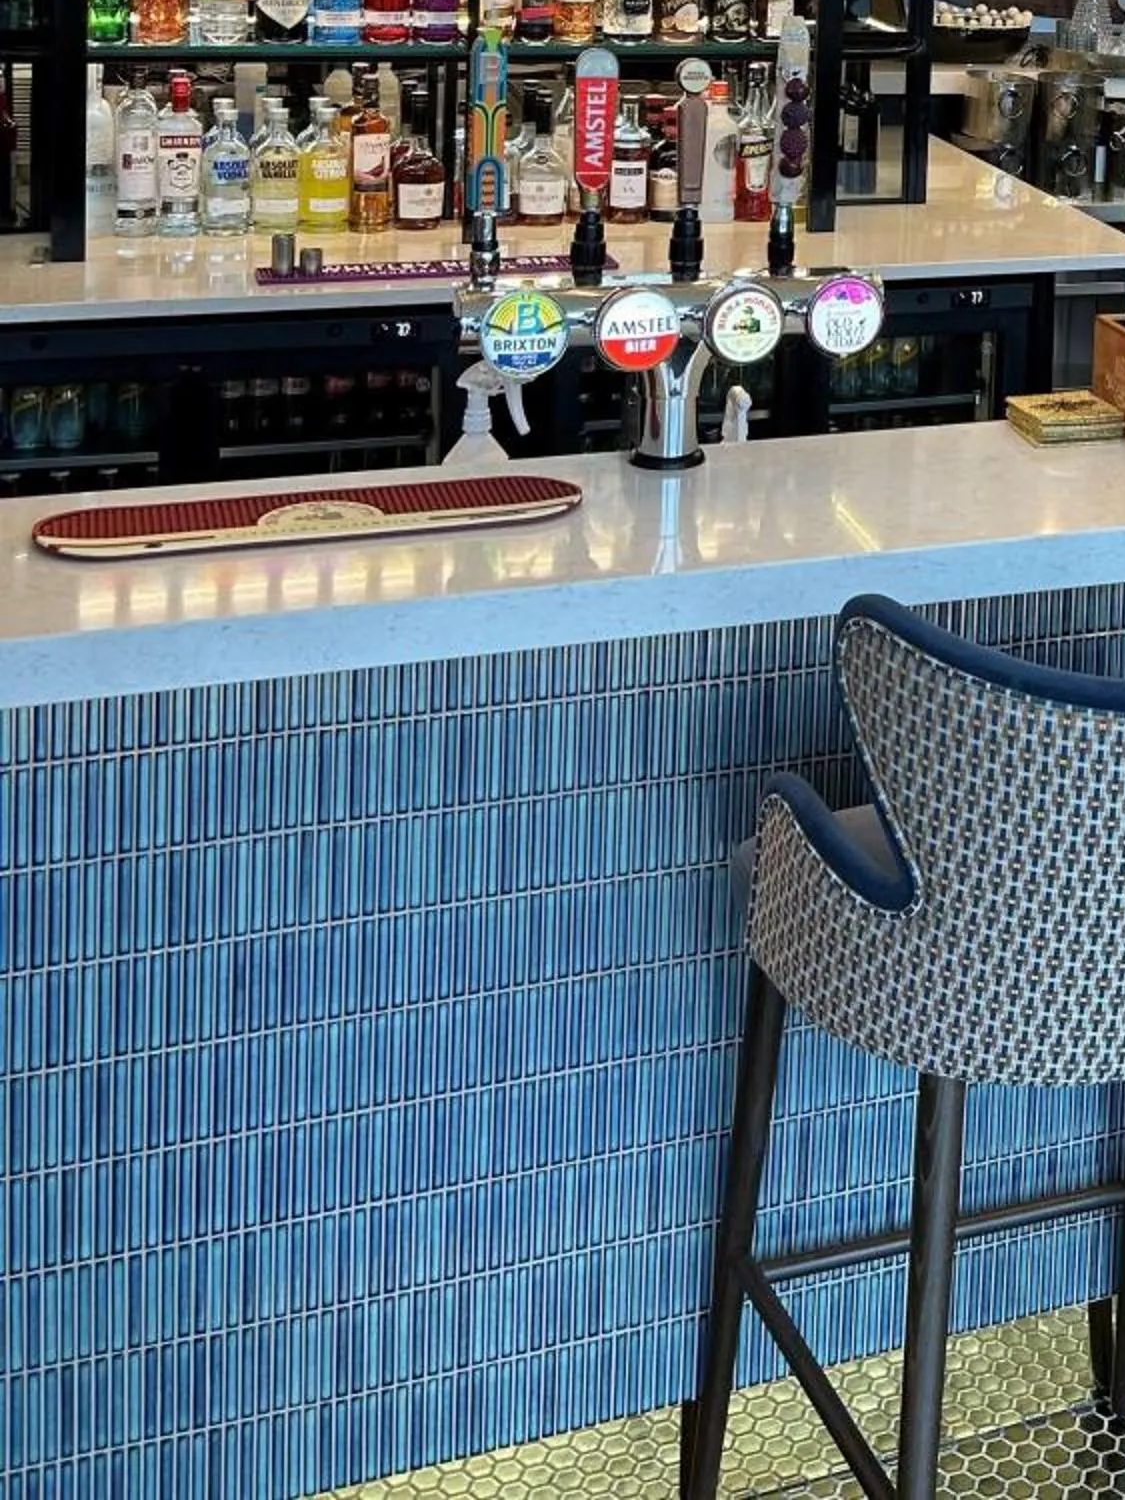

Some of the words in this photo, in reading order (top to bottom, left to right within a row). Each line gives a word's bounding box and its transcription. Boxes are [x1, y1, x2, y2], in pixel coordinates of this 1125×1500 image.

[583, 80, 609, 168] AMSTEL
[607, 316, 674, 336] AMSTEL
[493, 337, 557, 352] BRIXTON
[624, 338, 657, 355] BIER
